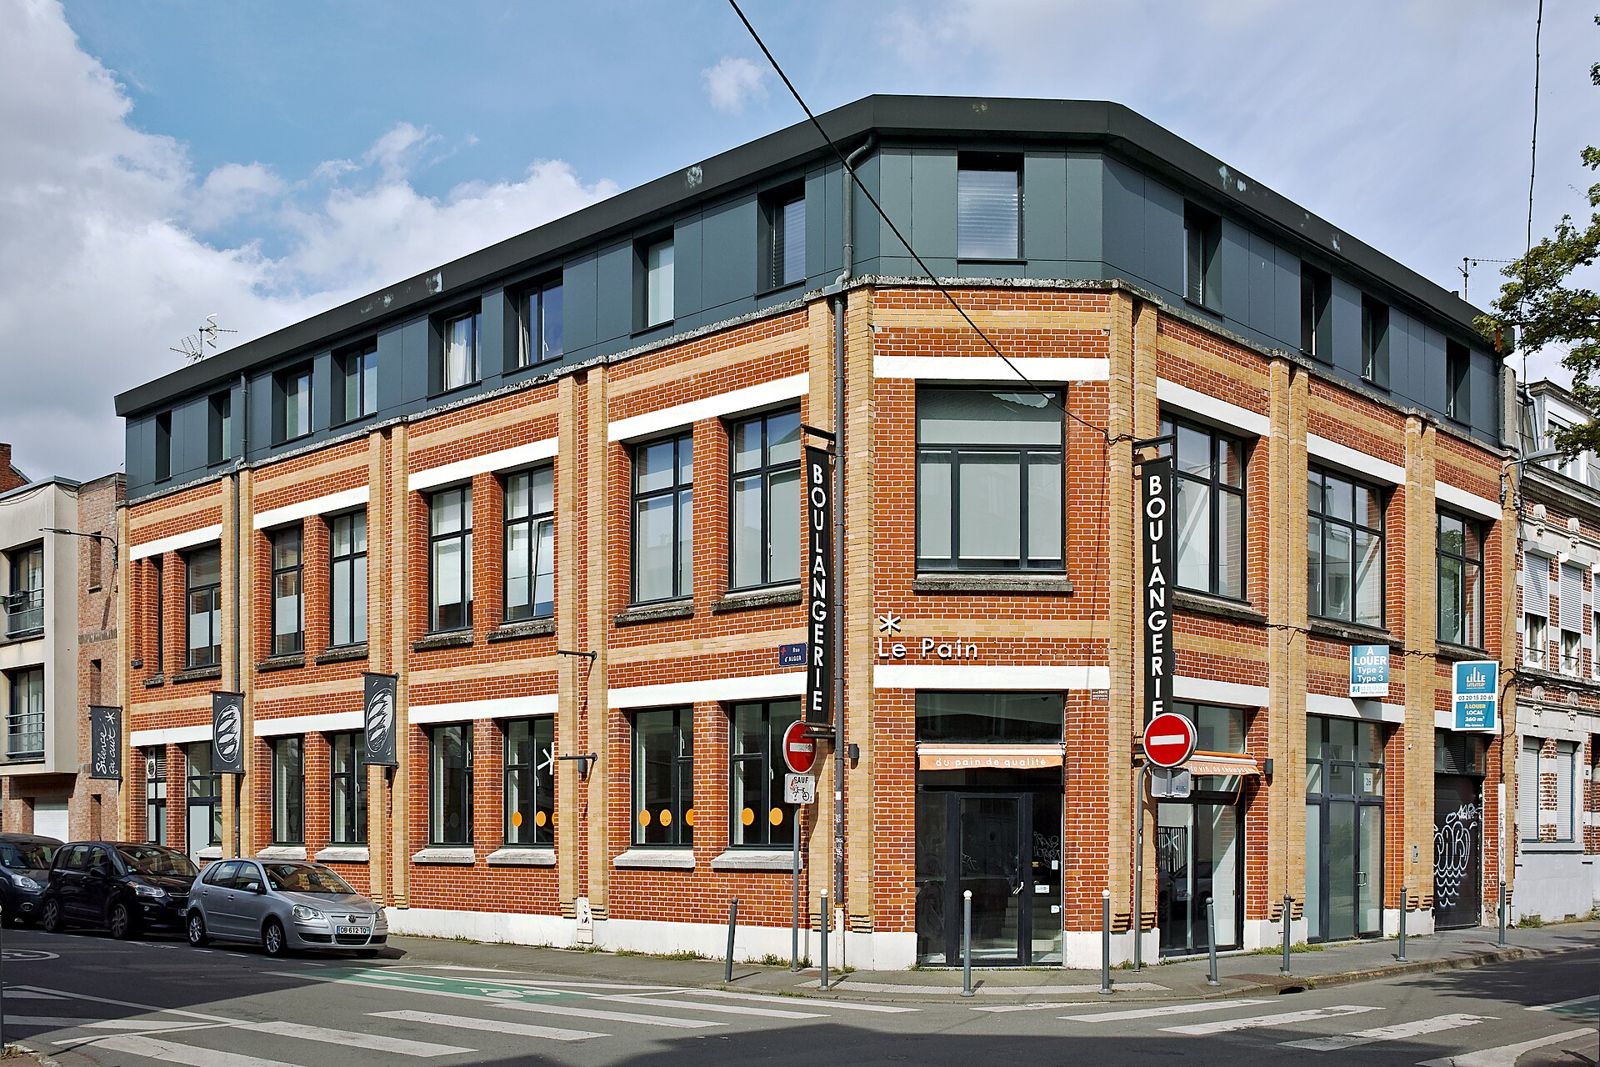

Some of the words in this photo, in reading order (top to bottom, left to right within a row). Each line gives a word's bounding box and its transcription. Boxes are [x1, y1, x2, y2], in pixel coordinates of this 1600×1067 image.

[811, 463, 827, 711] BOULANGERIE
[1146, 475, 1167, 719] BOULANGERIE
[878, 637, 907, 659] Le
[922, 637, 978, 660] Pain
[1354, 656, 1387, 666] LOUER
[1357, 666, 1377, 675] Type
[1378, 666, 1384, 674] 2
[1357, 674, 1377, 684] Type
[1378, 674, 1384, 682] 3
[955, 757, 981, 768] pain
[986, 757, 1000, 767] de
[793, 776, 809, 784] SAUF
